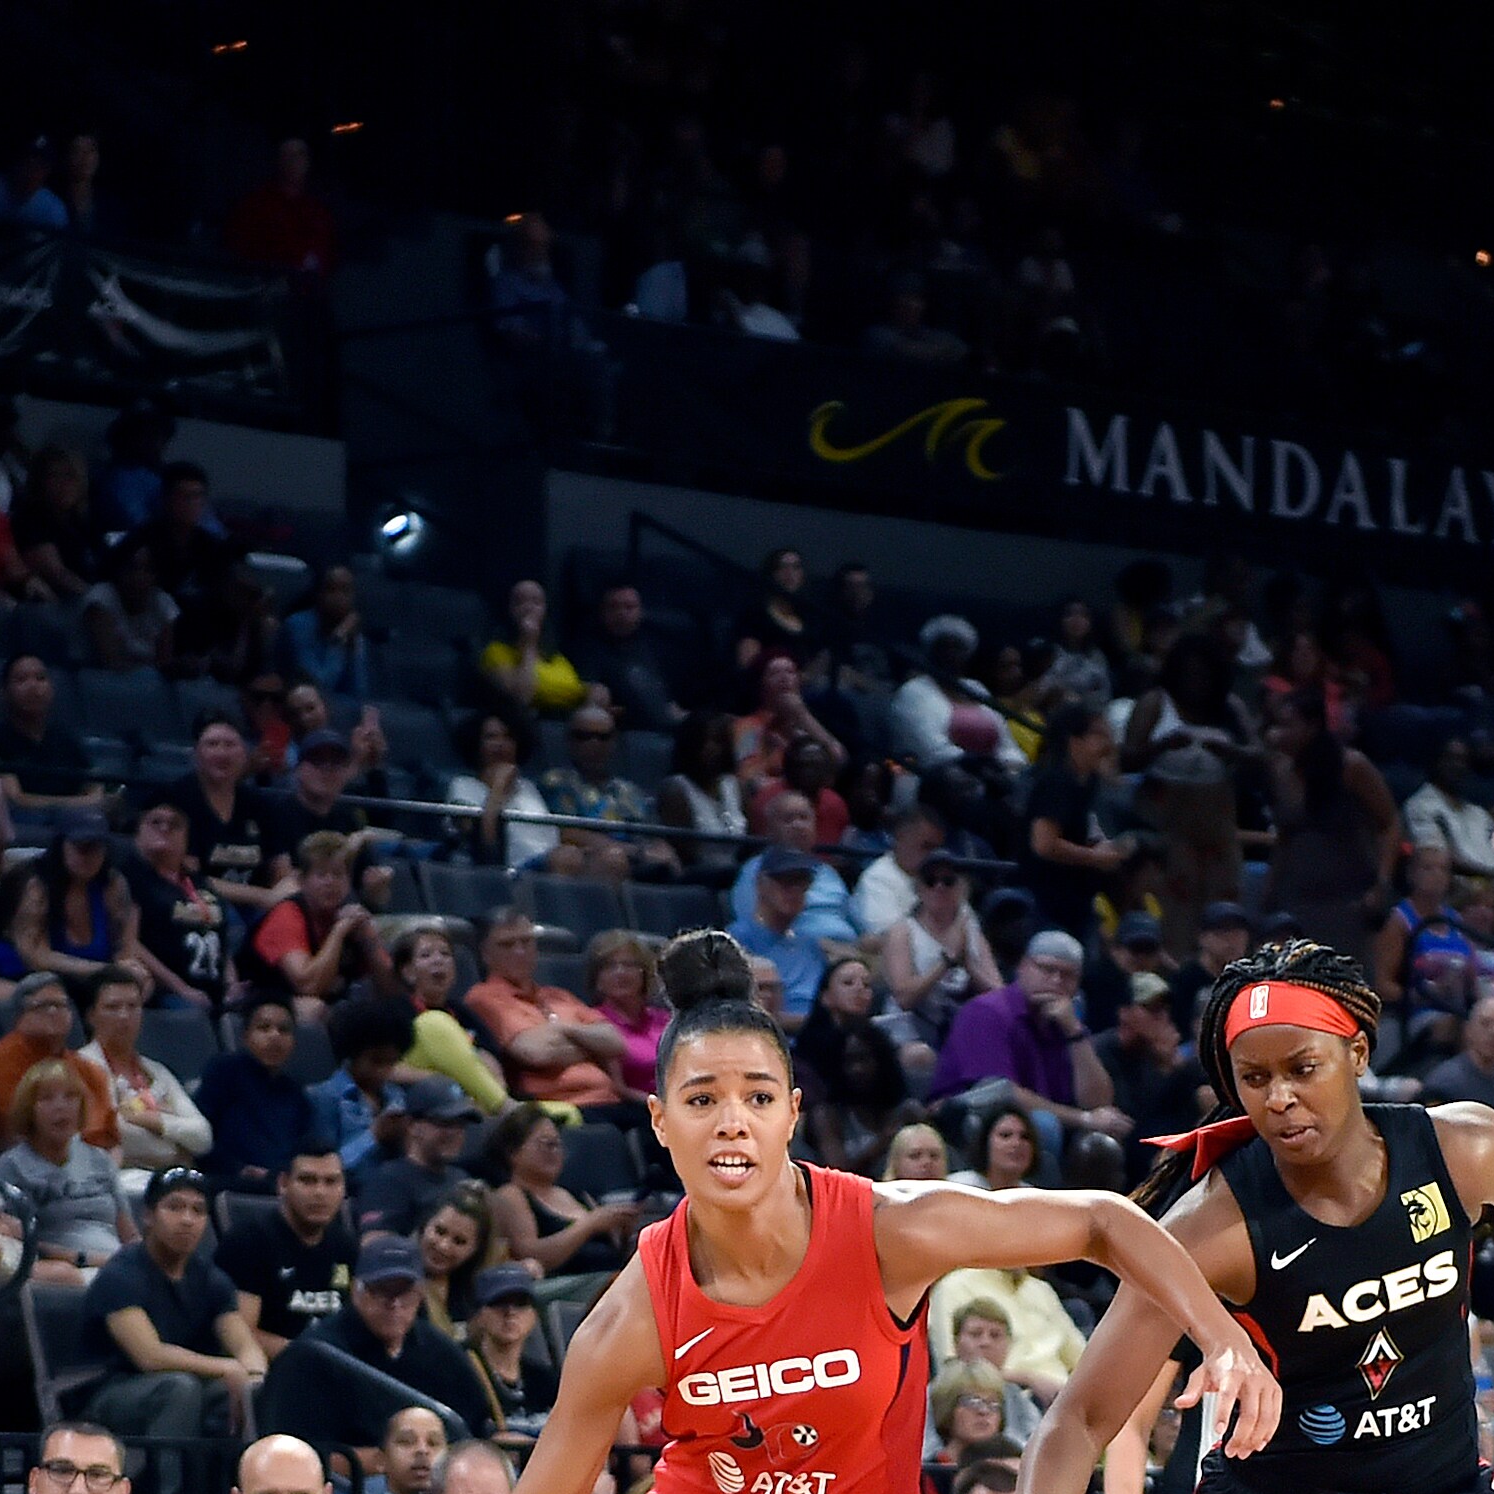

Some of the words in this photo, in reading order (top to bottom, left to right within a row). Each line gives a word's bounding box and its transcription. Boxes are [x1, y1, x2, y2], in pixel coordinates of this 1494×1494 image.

[1297, 1250, 1459, 1332] ACES
[677, 1348, 862, 1406] GEICO
[1353, 1396, 1437, 1440] AT&T
